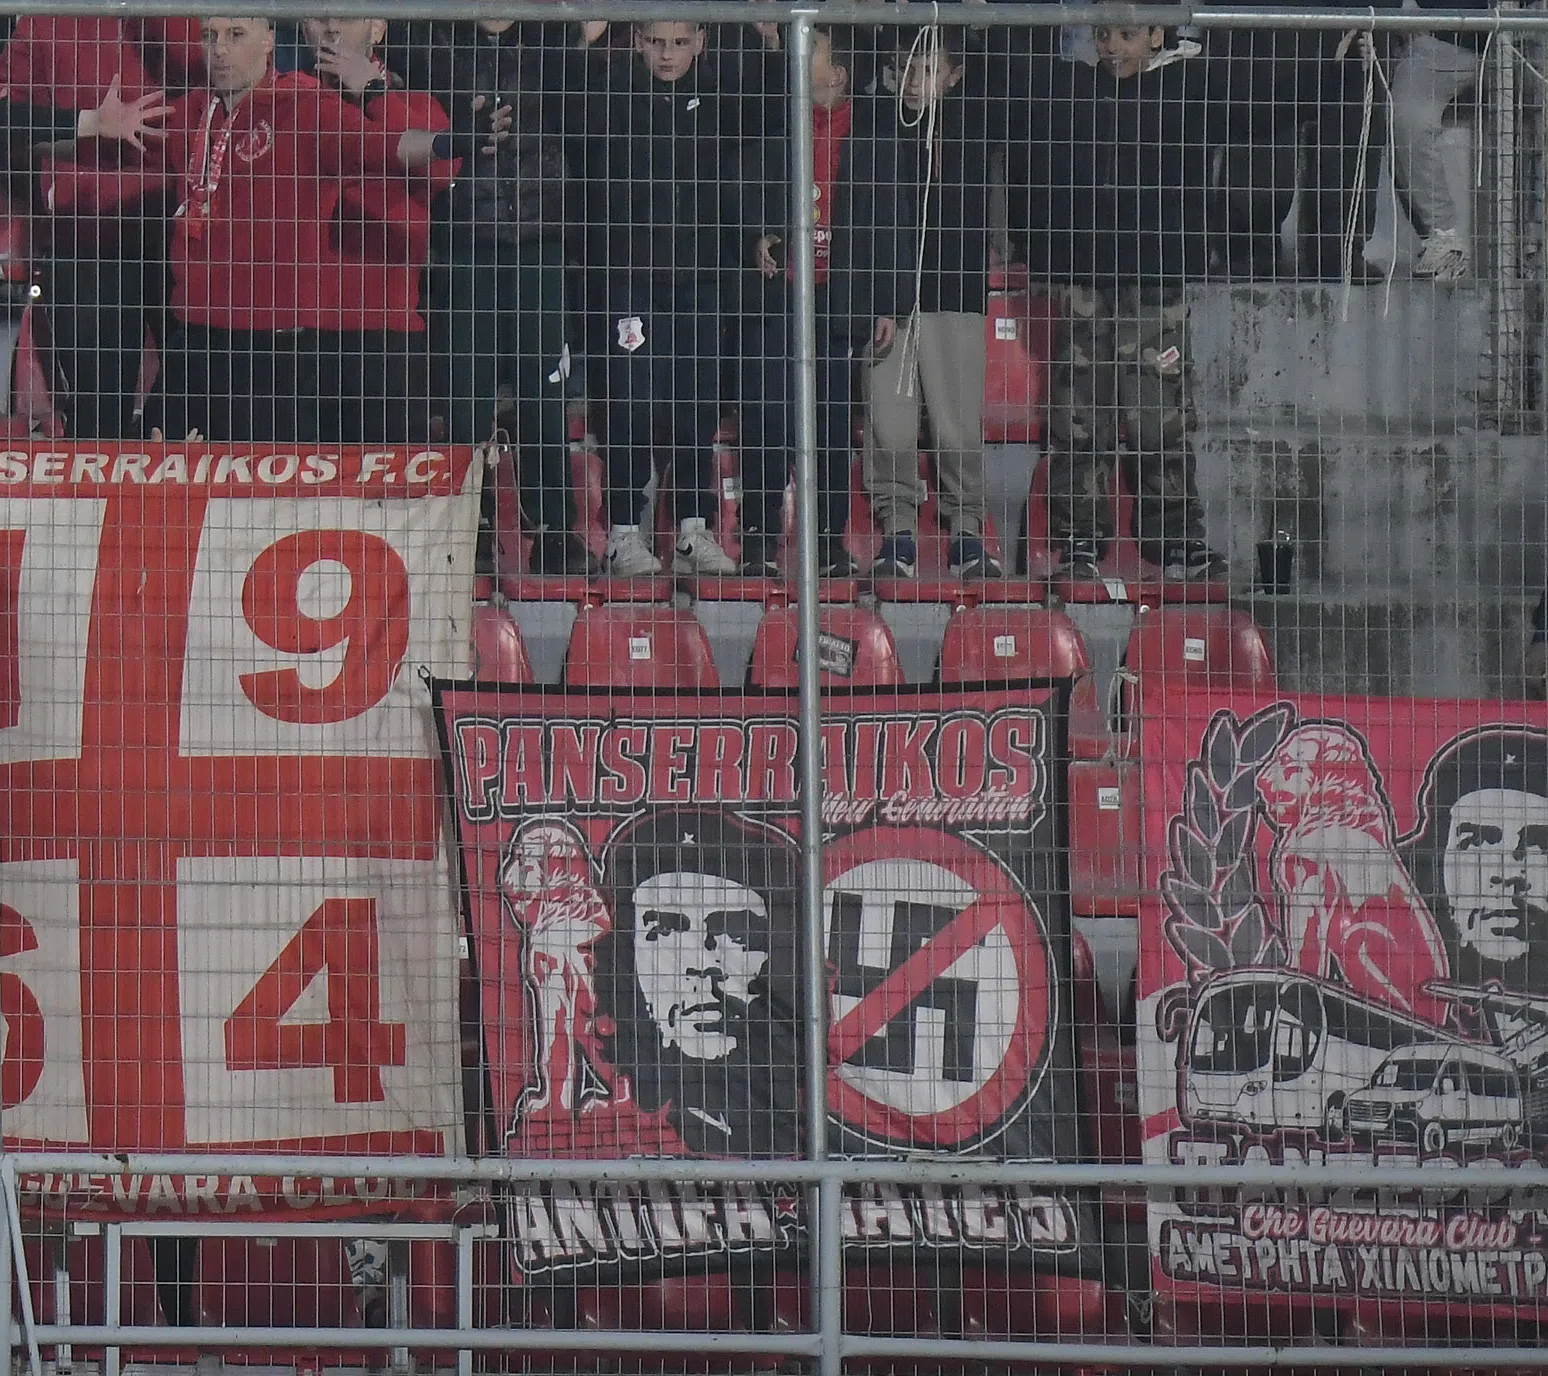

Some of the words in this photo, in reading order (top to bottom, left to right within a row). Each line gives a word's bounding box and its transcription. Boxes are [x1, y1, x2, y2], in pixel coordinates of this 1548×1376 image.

[357, 450, 451, 486] F.C.
[223, 897, 406, 1104] 4
[1242, 1205, 1304, 1240] Che
[1308, 1207, 1444, 1246] Guevara
[1445, 1214, 1517, 1249] Club
[1167, 1228, 1348, 1288] ΑΜΕΤΡΗΤΑ
